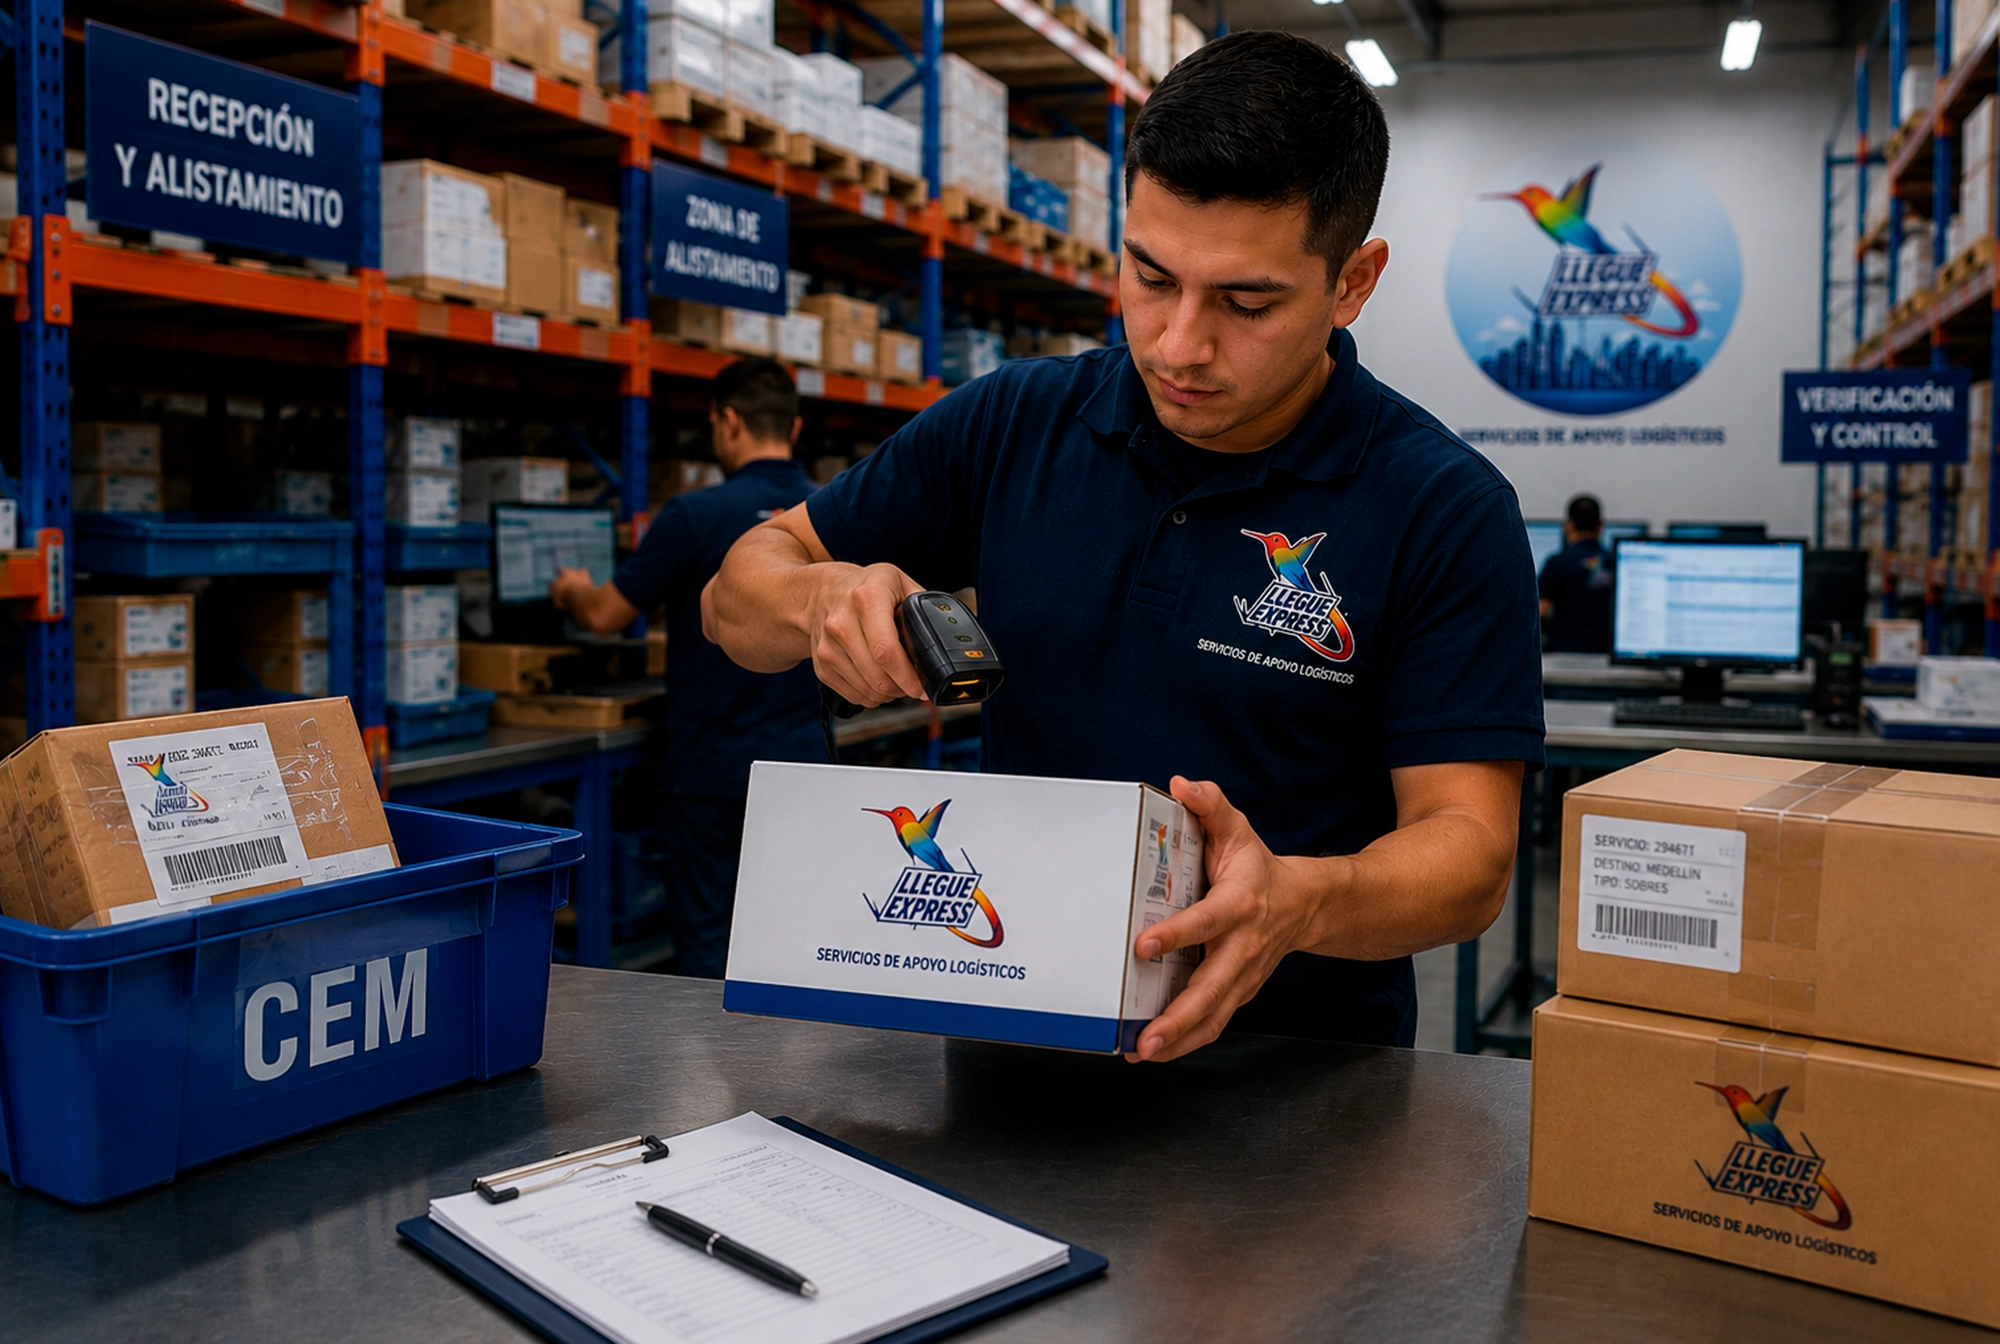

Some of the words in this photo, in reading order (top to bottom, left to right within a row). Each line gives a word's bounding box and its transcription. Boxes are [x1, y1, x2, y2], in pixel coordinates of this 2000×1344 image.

[148, 77, 315, 157] RECEPCIÓN
[114, 143, 138, 188] Y
[145, 152, 344, 228] ALISTAMIENTO
[685, 194, 735, 236] ZONA
[736, 208, 761, 243] DE
[664, 240, 779, 293] ALISTAMIENTO
[1796, 380, 1955, 412] VERIFICACIÓN
[1810, 422, 1828, 448] Y
[1831, 422, 1938, 448] CONTROL
[1265, 586, 1334, 617] LLEGUE
[1251, 605, 1331, 637] EXPRESS
[1197, 638, 1247, 660] SERVICIOS
[1247, 651, 1263, 664] DE
[1262, 656, 1298, 673] APOYO
[1300, 664, 1355, 685] LOGÍSTICOS
[1594, 833, 1650, 852] SERVICIO:
[897, 871, 976, 900] LLEGUE
[1594, 857, 1641, 873] DESTINO
[1646, 860, 1702, 880] MEDELLÍN
[1625, 878, 1669, 894] SOBRES
[884, 896, 973, 924] EXPRESS
[816, 947, 881, 967] SERVICIOS
[884, 954, 901, 968] DE
[902, 956, 948, 973] APOYO
[950, 959, 1027, 981] LOGÍSTICOS
[244, 947, 428, 1082] CEM
[1731, 1146, 1817, 1183] LLEGUE
[1719, 1169, 1817, 1206] EXPRESS
[1653, 1201, 1721, 1228] SERVICIOS
[1723, 1218, 1742, 1233] DE
[1744, 1223, 1793, 1245] APOYO
[1795, 1234, 1878, 1265] LOGÍSTICOS
